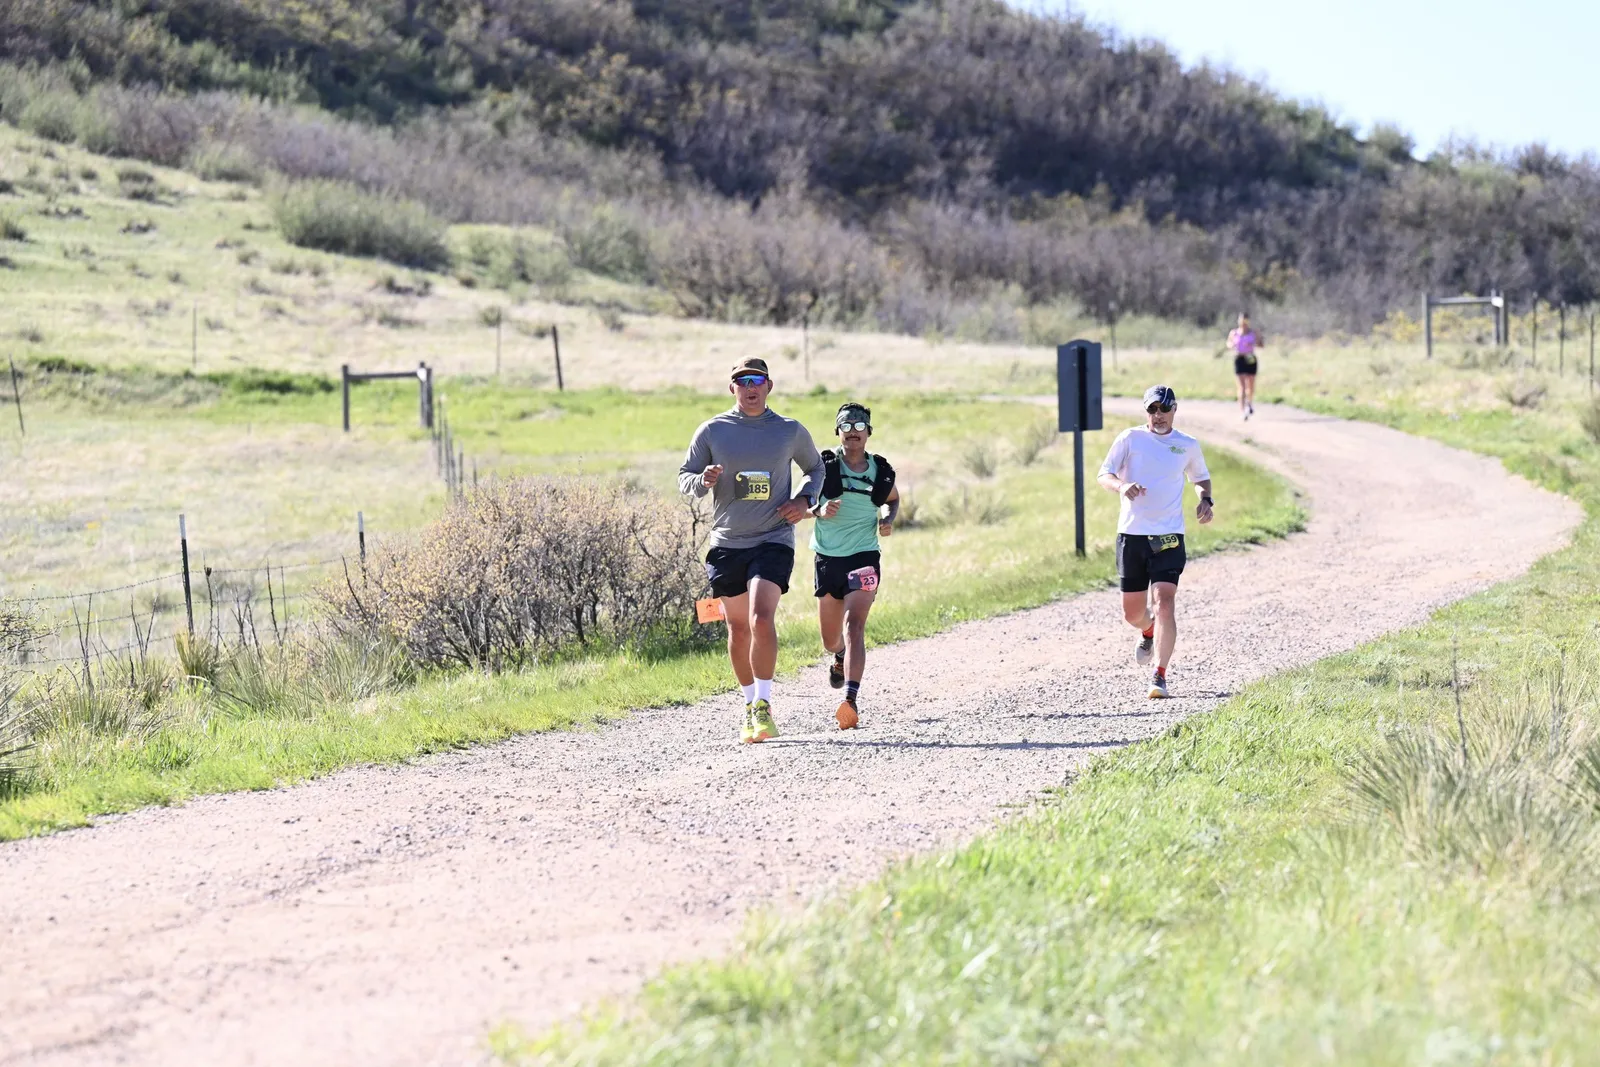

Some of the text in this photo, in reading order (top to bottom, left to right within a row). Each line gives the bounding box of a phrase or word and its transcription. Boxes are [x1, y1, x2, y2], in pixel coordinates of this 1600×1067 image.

[749, 484, 768, 494] 185
[1161, 535, 1177, 545] 159
[863, 576, 875, 586] 23
